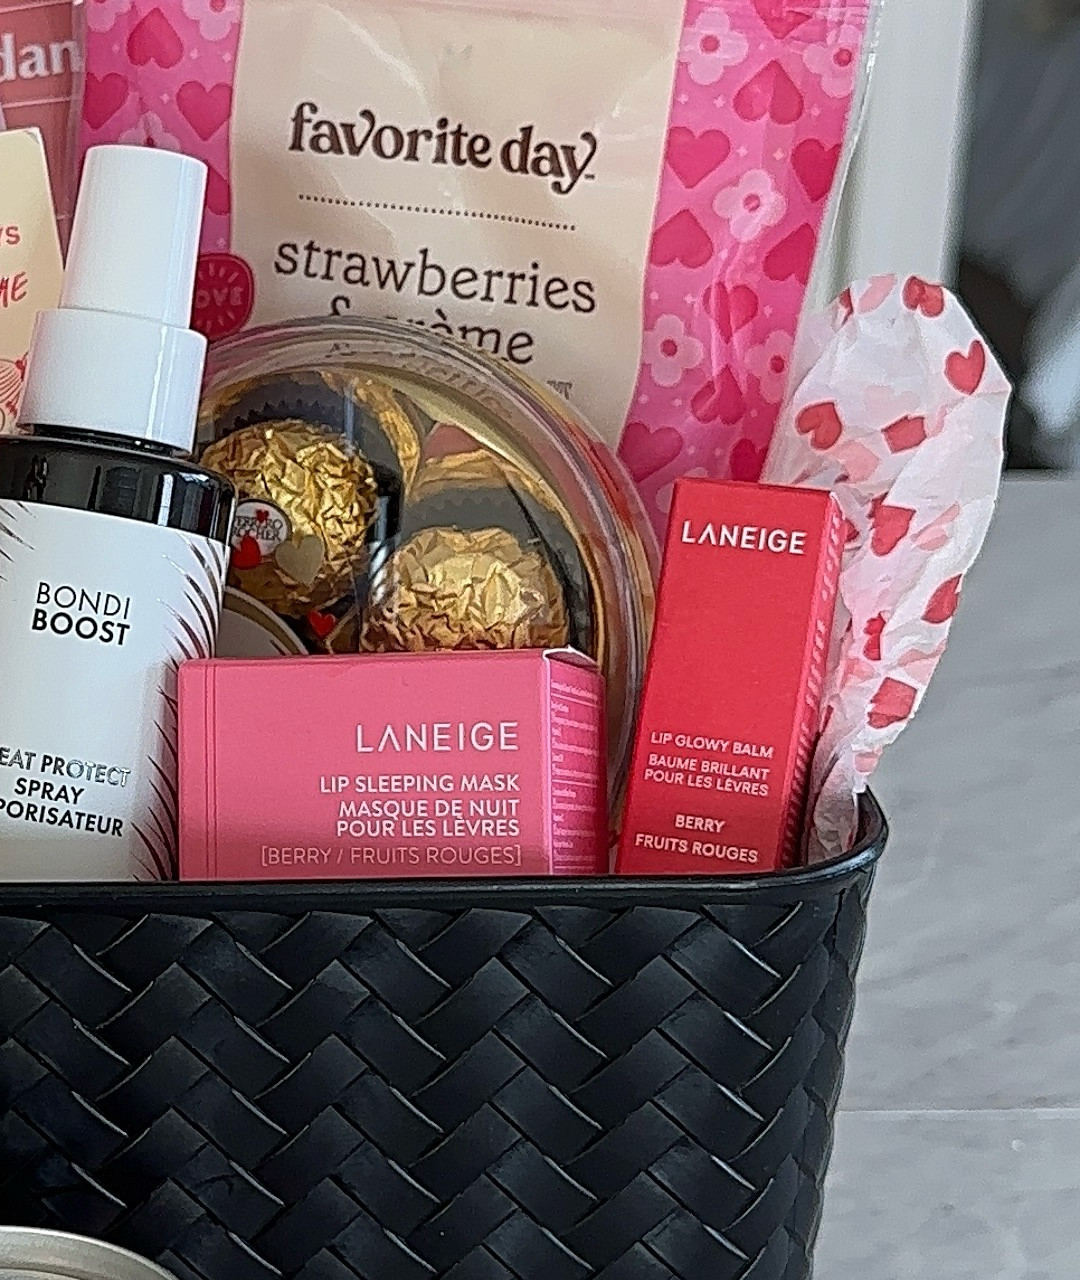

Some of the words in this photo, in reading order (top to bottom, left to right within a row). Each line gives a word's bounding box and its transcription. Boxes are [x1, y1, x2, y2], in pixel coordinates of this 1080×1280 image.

[288, 101, 493, 169] favorite
[499, 124, 598, 195] day
[274, 239, 597, 314] strawberries
[195, 286, 244, 308] OVE
[681, 520, 808, 556] LANEIGE
[35, 581, 132, 620] BONDI
[31, 609, 131, 646] BOOST
[356, 721, 520, 754] LANEIGE
[650, 731, 673, 746] LIP
[674, 734, 730, 753] GLOWY
[732, 741, 774, 759] BALM
[40, 754, 131, 788] PROTECT
[648, 753, 698, 773] BAUME
[700, 759, 771, 781] BRILLANT
[13, 776, 85, 806] SPRAY
[320, 776, 350, 794] LIP
[354, 774, 455, 793] SLEEPING
[460, 773, 520, 792] MASK
[644, 768, 685, 787] POUR
[686, 774, 714, 790] LES
[715, 775, 770, 797] LÈVRES
[338, 800, 428, 820] MASQUE
[435, 799, 463, 818] DE
[470, 798, 520, 817] NUIT
[674, 813, 725, 834] BERRY
[336, 820, 395, 838] POUR
[402, 819, 437, 837] LES
[442, 814, 520, 837] LÈVRES
[261, 846, 332, 867] [BERRY
[335, 847, 344, 865] /
[350, 846, 420, 865] FRUITS
[426, 845, 521, 866] ROUGES]
[635, 833, 688, 854] FRUITS
[691, 842, 759, 864] ROUGES
